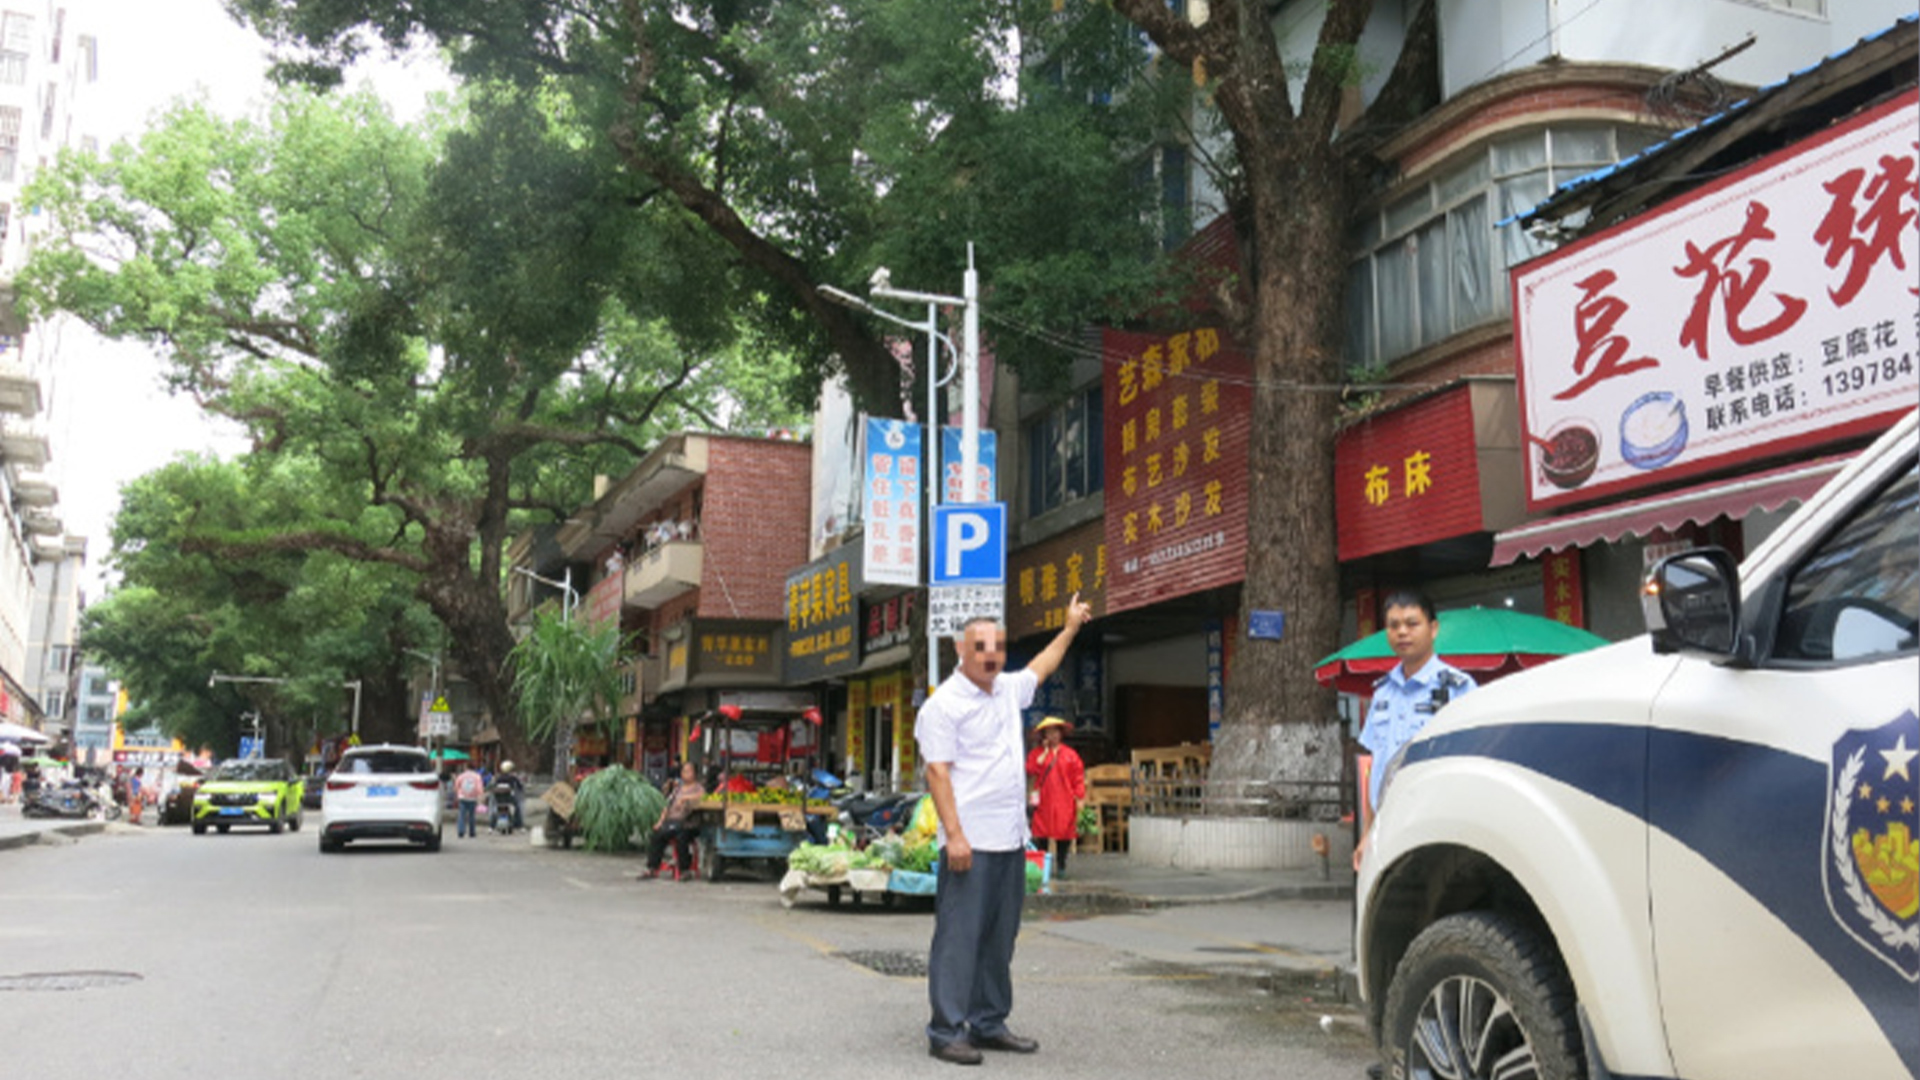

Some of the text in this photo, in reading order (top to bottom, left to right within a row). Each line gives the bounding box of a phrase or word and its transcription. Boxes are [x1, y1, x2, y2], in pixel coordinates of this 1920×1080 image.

[1822, 351, 1918, 396] 139784
[1364, 449, 1433, 506] 布床
[1122, 479, 1223, 546] 实木沙发
[945, 512, 990, 577] P
